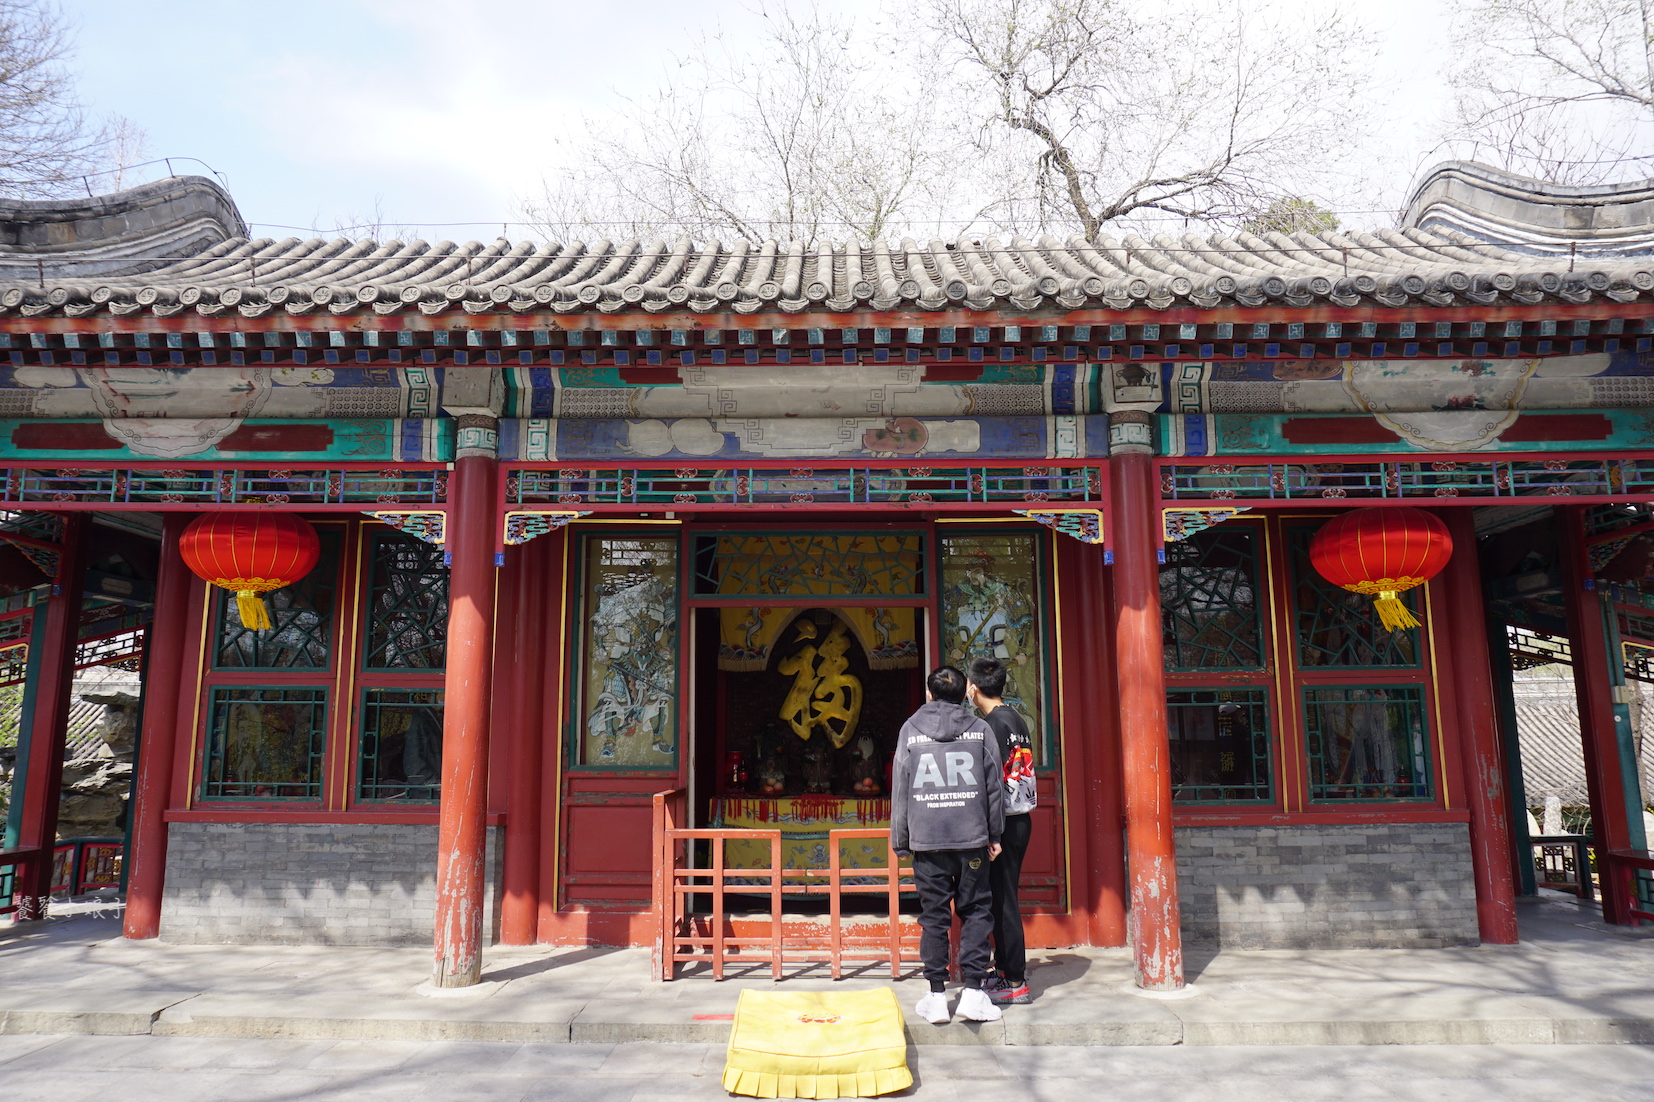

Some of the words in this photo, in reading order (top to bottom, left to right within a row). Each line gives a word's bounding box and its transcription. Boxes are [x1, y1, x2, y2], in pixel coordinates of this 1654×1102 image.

[913, 751, 978, 789] AR
[913, 793, 939, 801] "BLACK
[940, 791, 979, 800] EXTENDED"
